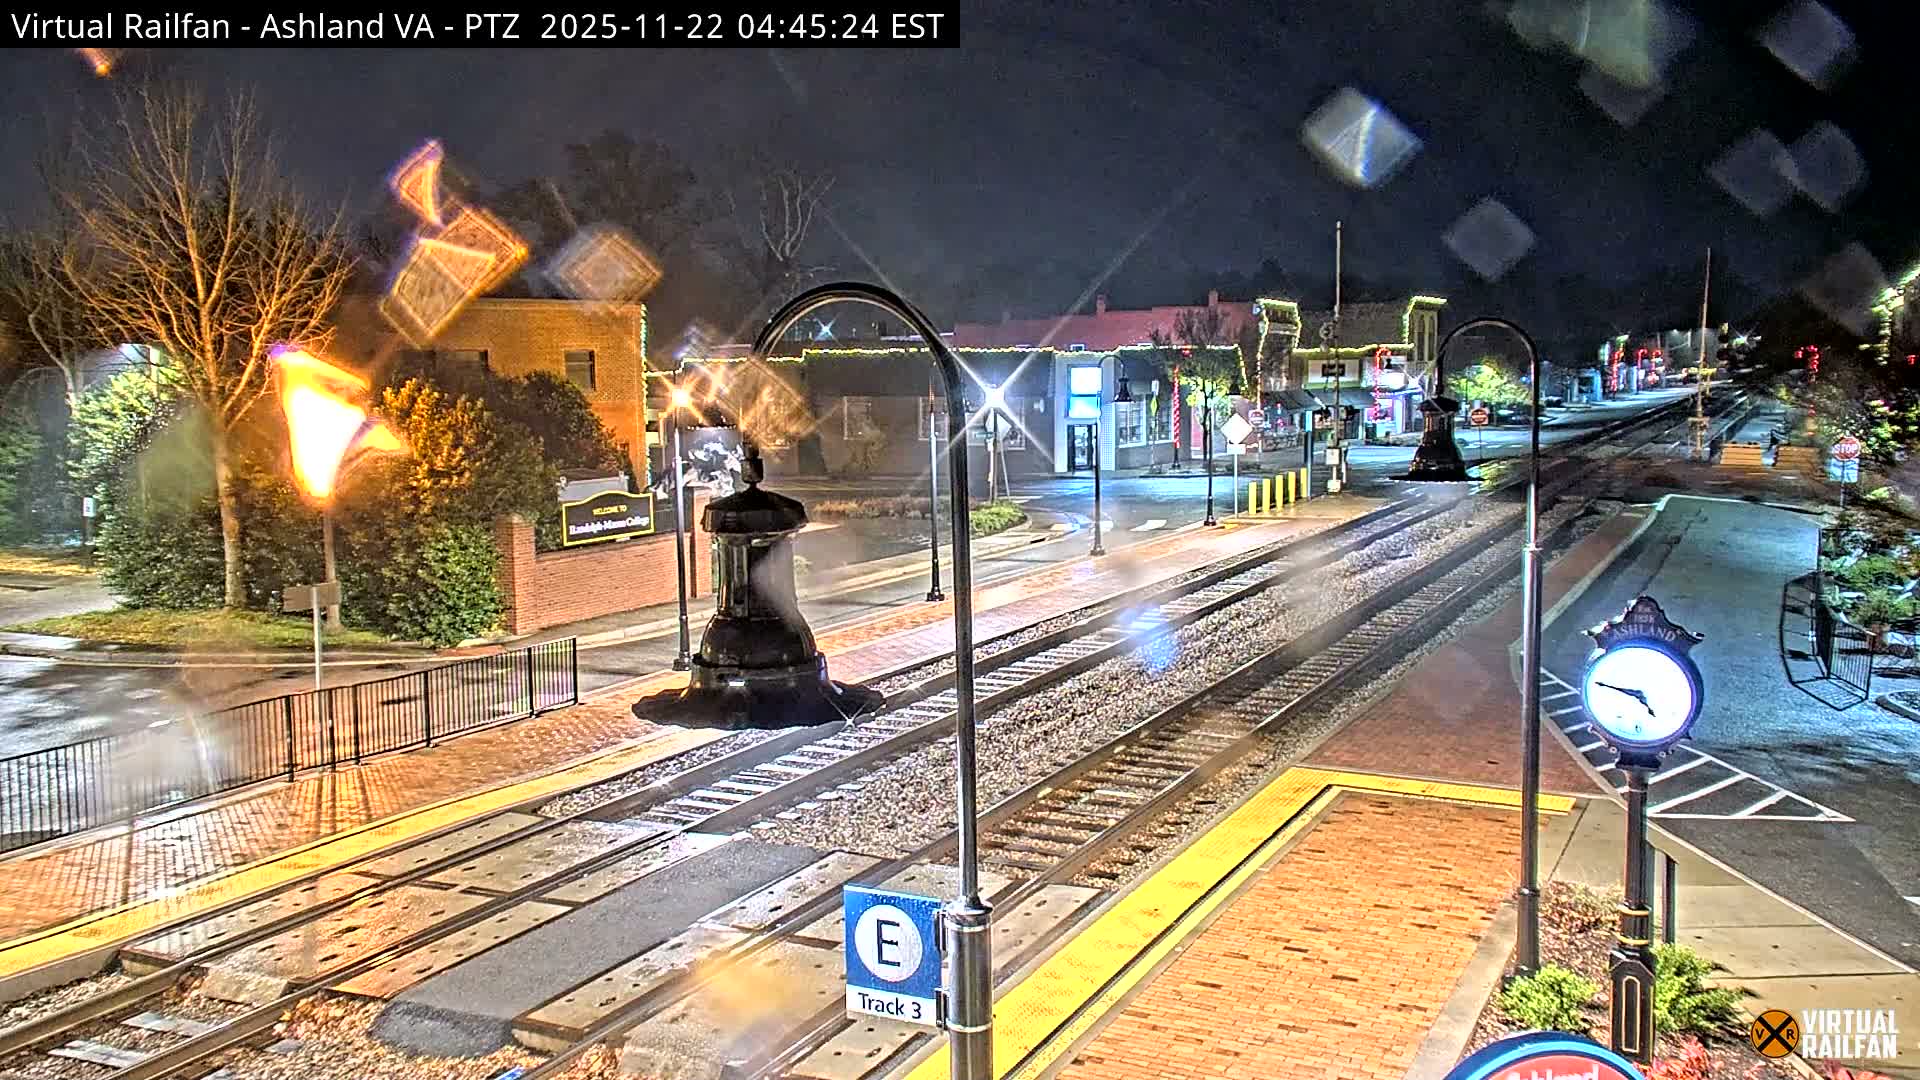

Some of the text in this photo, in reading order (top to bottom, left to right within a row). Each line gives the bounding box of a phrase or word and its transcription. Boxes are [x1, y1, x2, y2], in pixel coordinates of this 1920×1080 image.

[1834, 443, 1858, 454] STOP
[1614, 623, 1676, 642] ASHLAND
[876, 919, 901, 968] E
[858, 992, 922, 1020] Track 3
